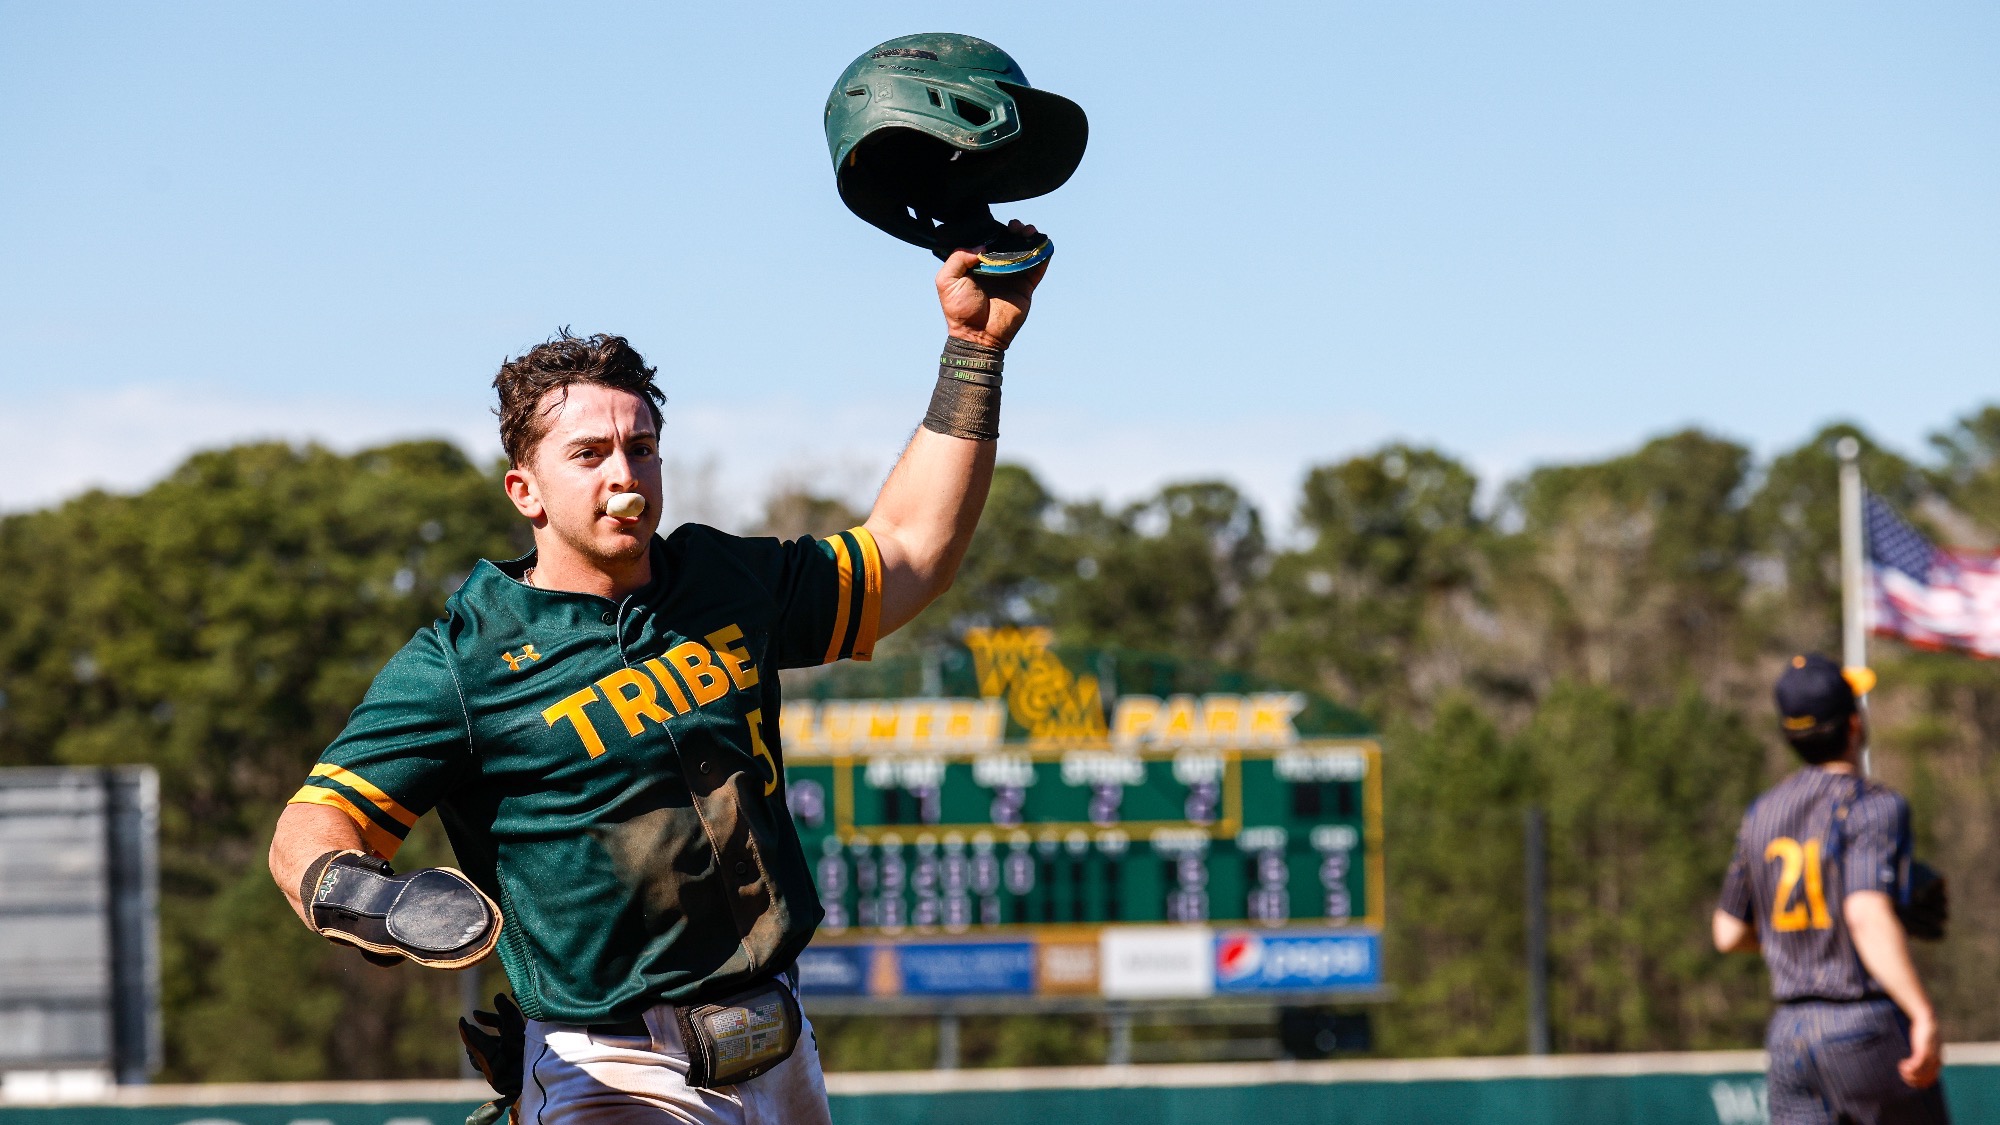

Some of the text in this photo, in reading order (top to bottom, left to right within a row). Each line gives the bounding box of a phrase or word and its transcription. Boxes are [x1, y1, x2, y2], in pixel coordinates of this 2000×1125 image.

[954, 371, 976, 381] TRIBE
[541, 623, 759, 760] TRIBE
[781, 693, 1304, 746] LUMERI PARK
[745, 707, 777, 797] 5
[1764, 836, 1833, 933] 21
